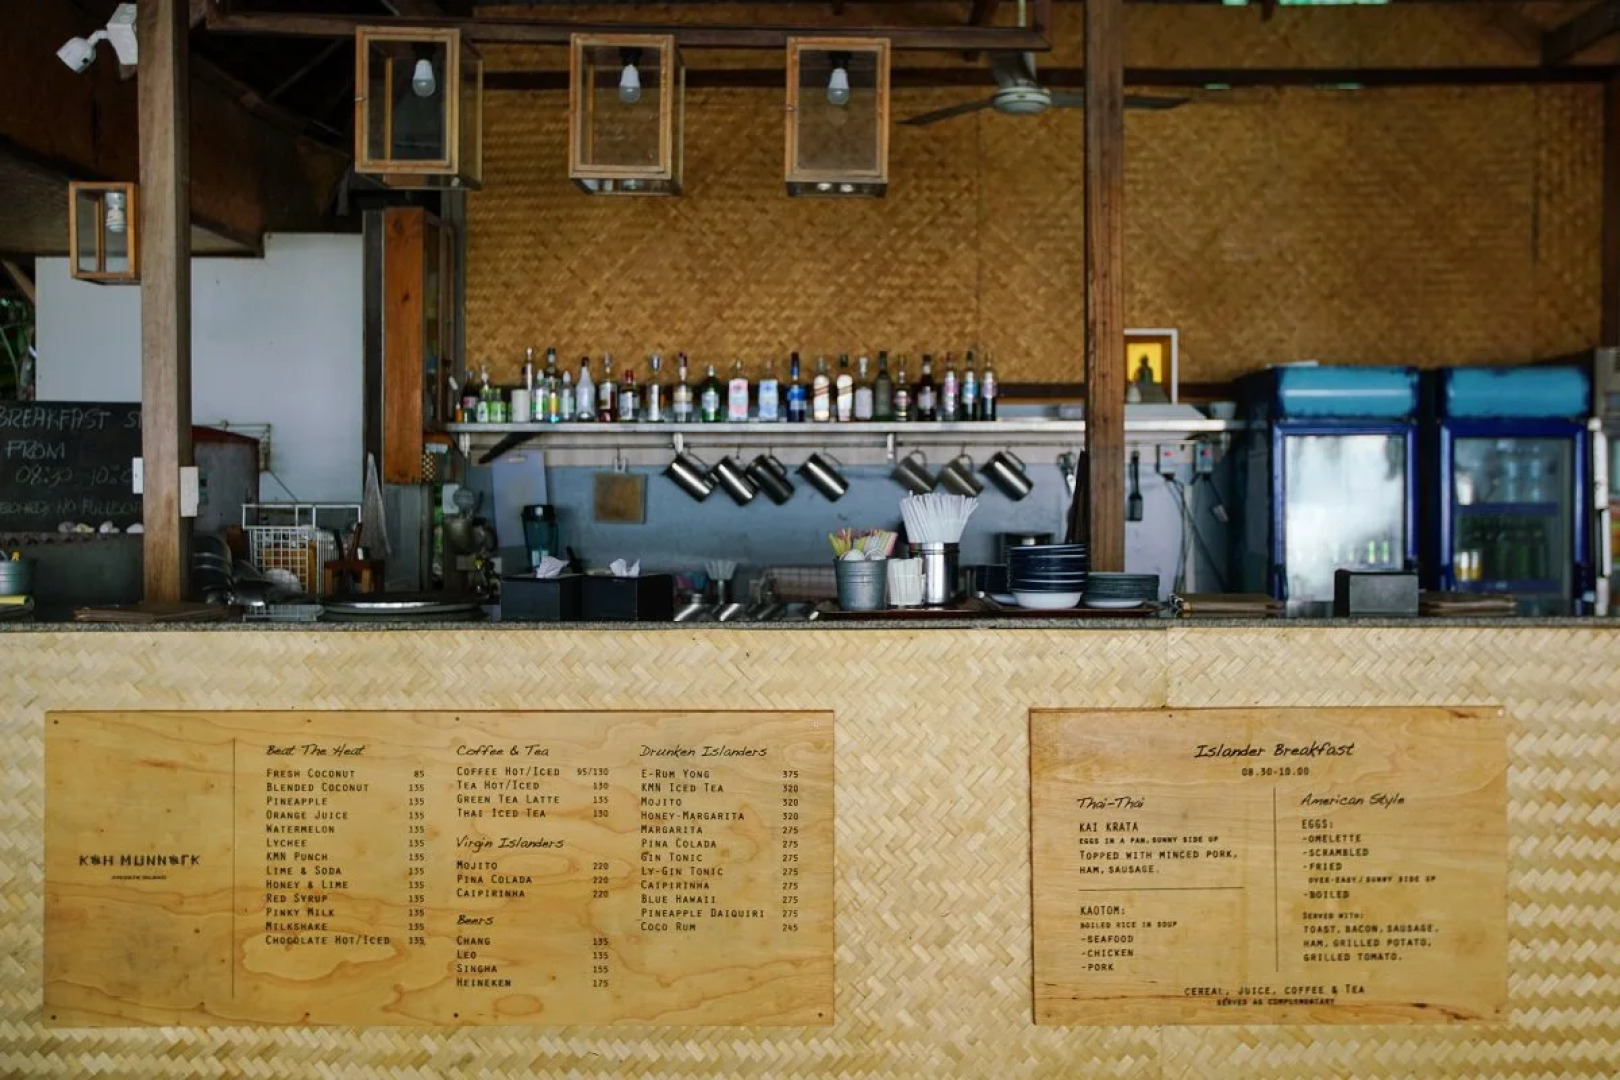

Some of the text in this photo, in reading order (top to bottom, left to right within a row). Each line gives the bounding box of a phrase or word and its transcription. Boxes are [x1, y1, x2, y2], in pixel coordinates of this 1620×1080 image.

[6, 440, 65, 460] FROM
[266, 744, 365, 757] Beat The Heat
[456, 745, 504, 756] Coffee
[525, 744, 549, 756] Tea
[640, 744, 767, 758] Drunken Islanders
[1194, 742, 1355, 758] Islander Breakfast
[266, 768, 424, 778] FRESH COCONUT 85
[457, 766, 497, 777] COFFEE
[505, 766, 559, 776] HOT/ICED
[641, 768, 798, 779] E-RUM YONG 375
[266, 782, 314, 792] BLENDED
[321, 781, 368, 793] COCONUT
[457, 780, 477, 790] TEA
[484, 779, 539, 790] HOT/ICED
[641, 782, 798, 793] KMN ICED TEA 320
[267, 796, 424, 806] PINEAPPLE 135
[457, 794, 609, 804] GREEN TEA LATTE 135
[641, 797, 798, 807] MOJITO 320
[1076, 796, 1145, 810] Thai-Thai
[1300, 792, 1404, 809] American Style
[266, 810, 424, 820] ORANGE JUICE 135
[458, 808, 483, 818] THAI
[492, 808, 518, 818] ICED
[527, 808, 546, 818] TEA
[641, 810, 798, 821] HONEY-MARGARITA 320
[266, 824, 335, 834] WATERMELON
[641, 823, 798, 834] MARGARITA 275
[1080, 821, 1138, 833] KAI KRATA
[267, 838, 425, 849] LYCHEE 135
[456, 835, 564, 853] Virgin Islanders
[641, 837, 798, 848] PINA COLADA 275
[266, 851, 425, 862] KMN PUNCH 135
[641, 851, 798, 862] GIN TONIC 275
[1080, 850, 1119, 860] TOPPED
[1126, 851, 1152, 860] WITH
[1159, 849, 1199, 859] MINCED
[266, 865, 293, 875] LIME
[314, 865, 342, 875] SODA
[409, 867, 424, 876] 135
[456, 860, 609, 870] MOJITO 220
[641, 866, 798, 877] LY-GIN TONIC 275
[457, 874, 609, 884] PINA COLADA 220
[640, 879, 798, 890] CAIPIRINHA 275
[266, 880, 301, 890] HONEY
[322, 880, 348, 889] LIME
[409, 881, 424, 889] 135
[265, 892, 424, 904] RED SYRUP 135
[456, 887, 609, 898] CAIPIRINHA 220
[641, 894, 798, 904] BLUE HAWAII 275
[266, 907, 425, 917] PINKY MILK 135
[641, 908, 798, 918] PINEAPPLE DAIQUIRI 275
[266, 921, 424, 931] MILKSHAKE 135
[457, 914, 494, 927] Beers
[641, 921, 668, 931] COCO
[676, 922, 696, 932] RUM
[265, 934, 425, 946] CHOCOLATE HOT/ICED 135
[457, 935, 609, 946] CHANG 135
[457, 949, 609, 959] LEO 135
[1304, 953, 1350, 961] GRILLED
[457, 963, 497, 973] SINGHA
[456, 977, 609, 988] HEINEKEN 175
[1285, 986, 1324, 995] COFFEE
[1346, 984, 1365, 994] TEA
